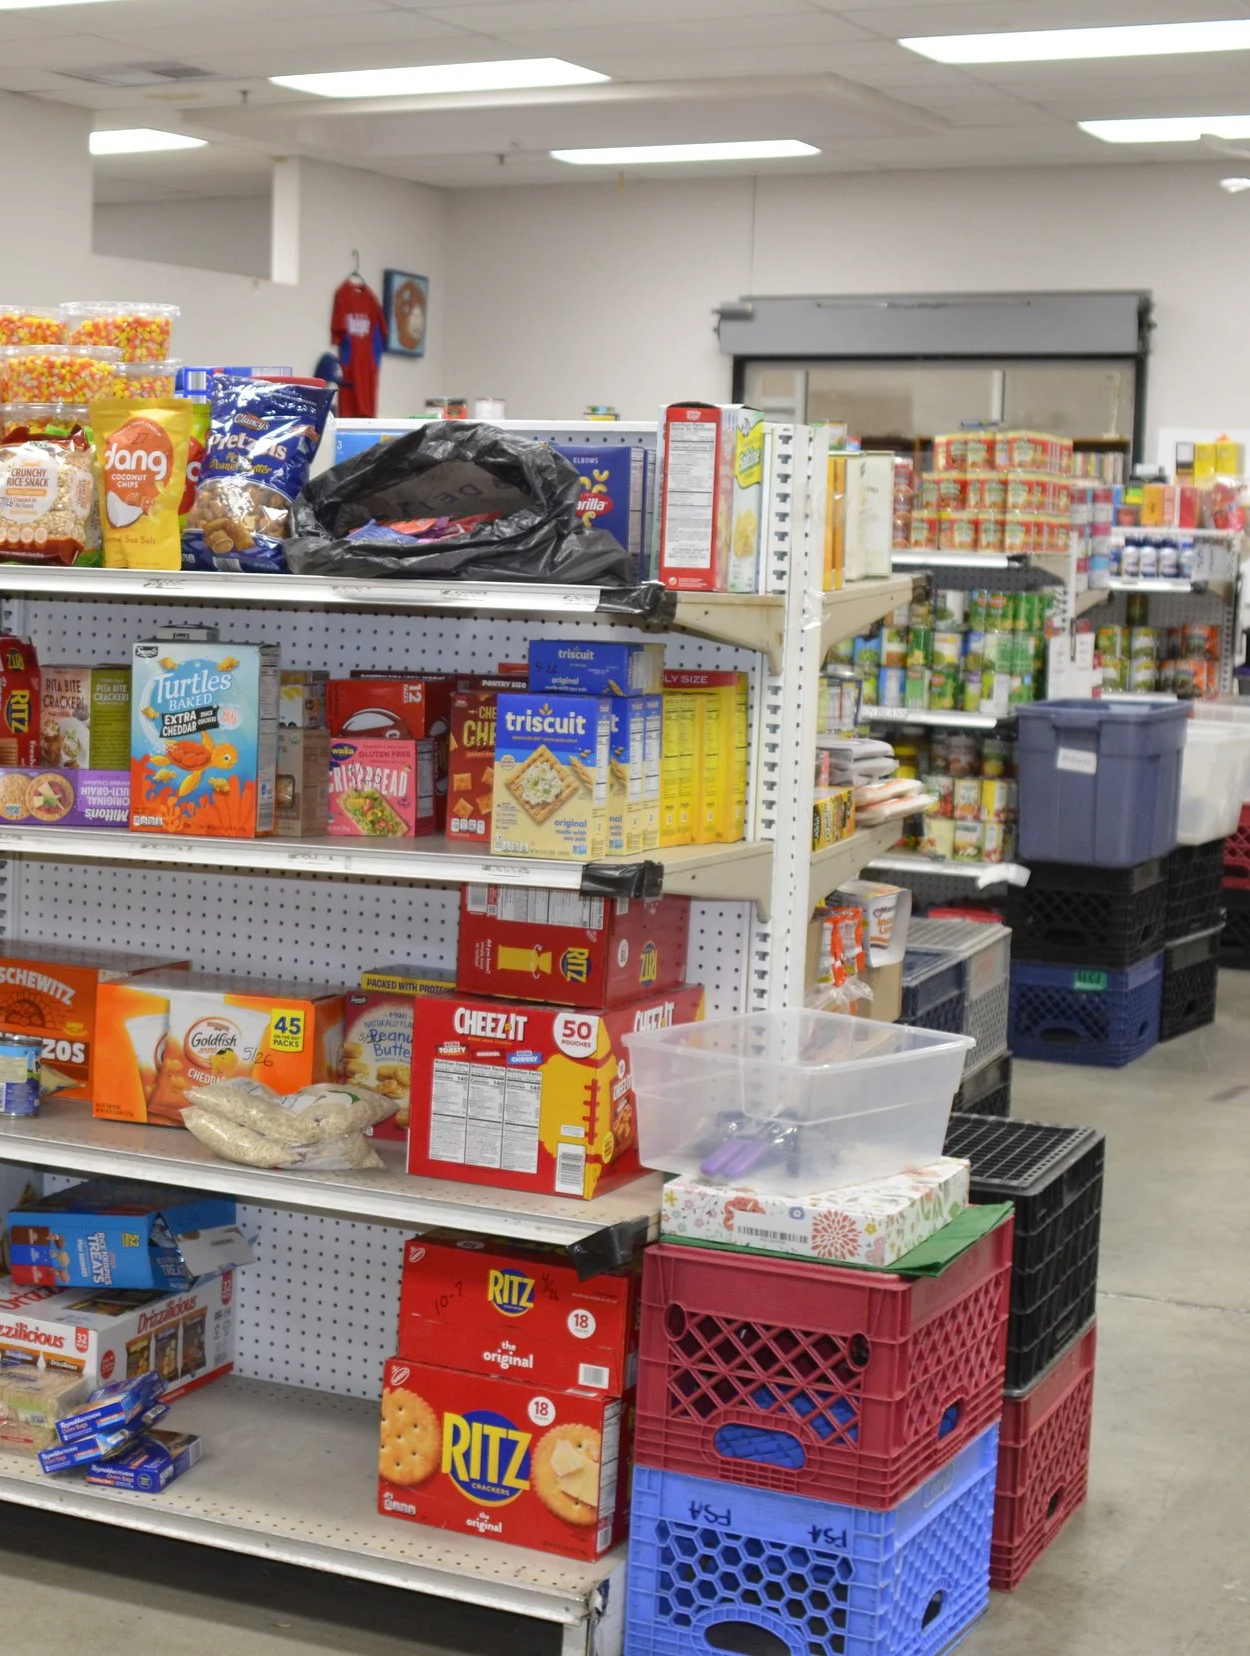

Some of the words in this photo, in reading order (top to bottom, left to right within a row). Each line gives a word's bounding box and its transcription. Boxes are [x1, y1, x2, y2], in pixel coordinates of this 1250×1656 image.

[234, 413, 270, 431] Clancy's
[105, 443, 167, 481] dang
[573, 457, 599, 465] ELBOWS
[11, 469, 46, 477] CRUNCHY
[7, 478, 23, 487] RICE
[25, 478, 49, 487] SNACK
[117, 481, 139, 489] CHIPS
[8, 653, 25, 670] RITZ
[557, 649, 595, 660] triscuit
[45, 679, 62, 692] PITA
[67, 680, 81, 693] BITE
[154, 670, 233, 704] Turtles
[482, 680, 509, 688] PANTRY
[551, 677, 579, 685] original
[681, 675, 708, 684] SIZE
[96, 685, 110, 693] PITA
[113, 685, 127, 693] BITE
[409, 684, 422, 703] 12
[43, 695, 85, 710] CRACKERS
[94, 693, 129, 701] CRACKERS
[169, 693, 213, 711] BAKED
[11, 690, 30, 734] RITZ
[164, 711, 196, 726] EXTRA
[162, 721, 197, 737] CHEDDAR
[505, 710, 587, 735] triscuit
[86, 797, 130, 806] ORIGINAL
[85, 808, 129, 822] Milton's
[554, 819, 587, 828] original
[566, 947, 589, 984] RITZ
[639, 947, 658, 983] RITZ
[367, 979, 396, 989] PACKED
[398, 982, 417, 990] WITH
[274, 1016, 301, 1035] 45
[562, 1020, 592, 1040] 50
[191, 1032, 237, 1048] Goldfish
[273, 1039, 300, 1048] PACKS
[370, 1029, 412, 1043] Peanu
[562, 1039, 591, 1048] POUCHES
[242, 1046, 274, 1068] 5/26
[374, 1043, 409, 1058] Butte
[87, 1233, 104, 1285] TREATS
[489, 1268, 536, 1309] RITZ
[137, 1295, 198, 1334] Drizzilicious
[573, 1313, 589, 1329] 18
[76, 1334, 88, 1343] 32
[501, 1340, 517, 1352] the
[482, 1351, 534, 1370] original
[534, 1400, 549, 1416] 18
[61, 1425, 75, 1434] Oven
[76, 1422, 88, 1430] Bags
[441, 1411, 533, 1491] RITZ
[91, 1464, 114, 1473] Reynolds
[471, 1482, 510, 1497] CRACKERS
[479, 1511, 490, 1520] the
[466, 1515, 502, 1534] original
